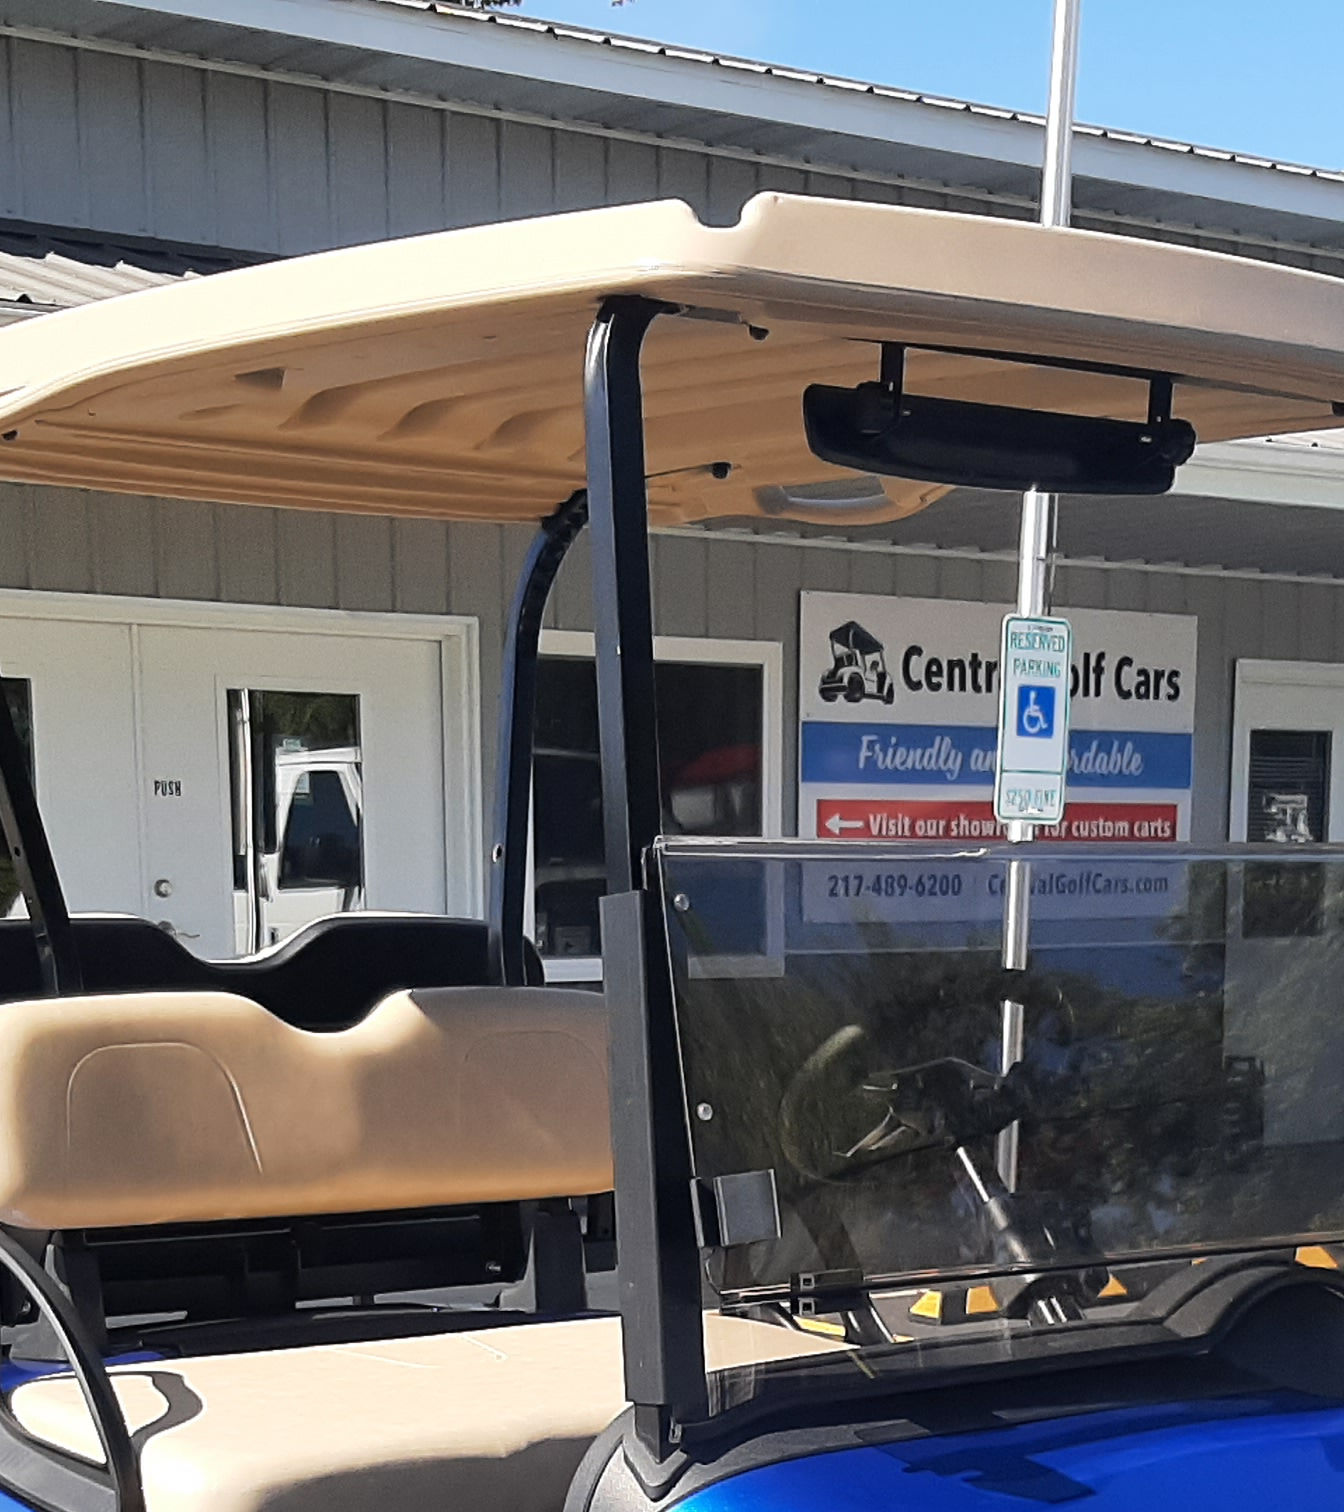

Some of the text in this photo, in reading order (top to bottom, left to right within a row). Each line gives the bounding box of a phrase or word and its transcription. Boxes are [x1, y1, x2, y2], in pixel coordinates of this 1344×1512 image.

[1010, 632, 1065, 652] RESERVED
[902, 645, 998, 693] Centr
[1114, 656, 1182, 702] Cars
[1013, 658, 1061, 678] PARKING
[858, 735, 1145, 780] Friendly an rdable
[154, 780, 181, 796] PUSH
[869, 814, 911, 836] Visit
[915, 819, 946, 837] our
[1071, 818, 1129, 838] custom
[1133, 818, 1171, 838] carts
[828, 873, 962, 897] 217-489-6200
